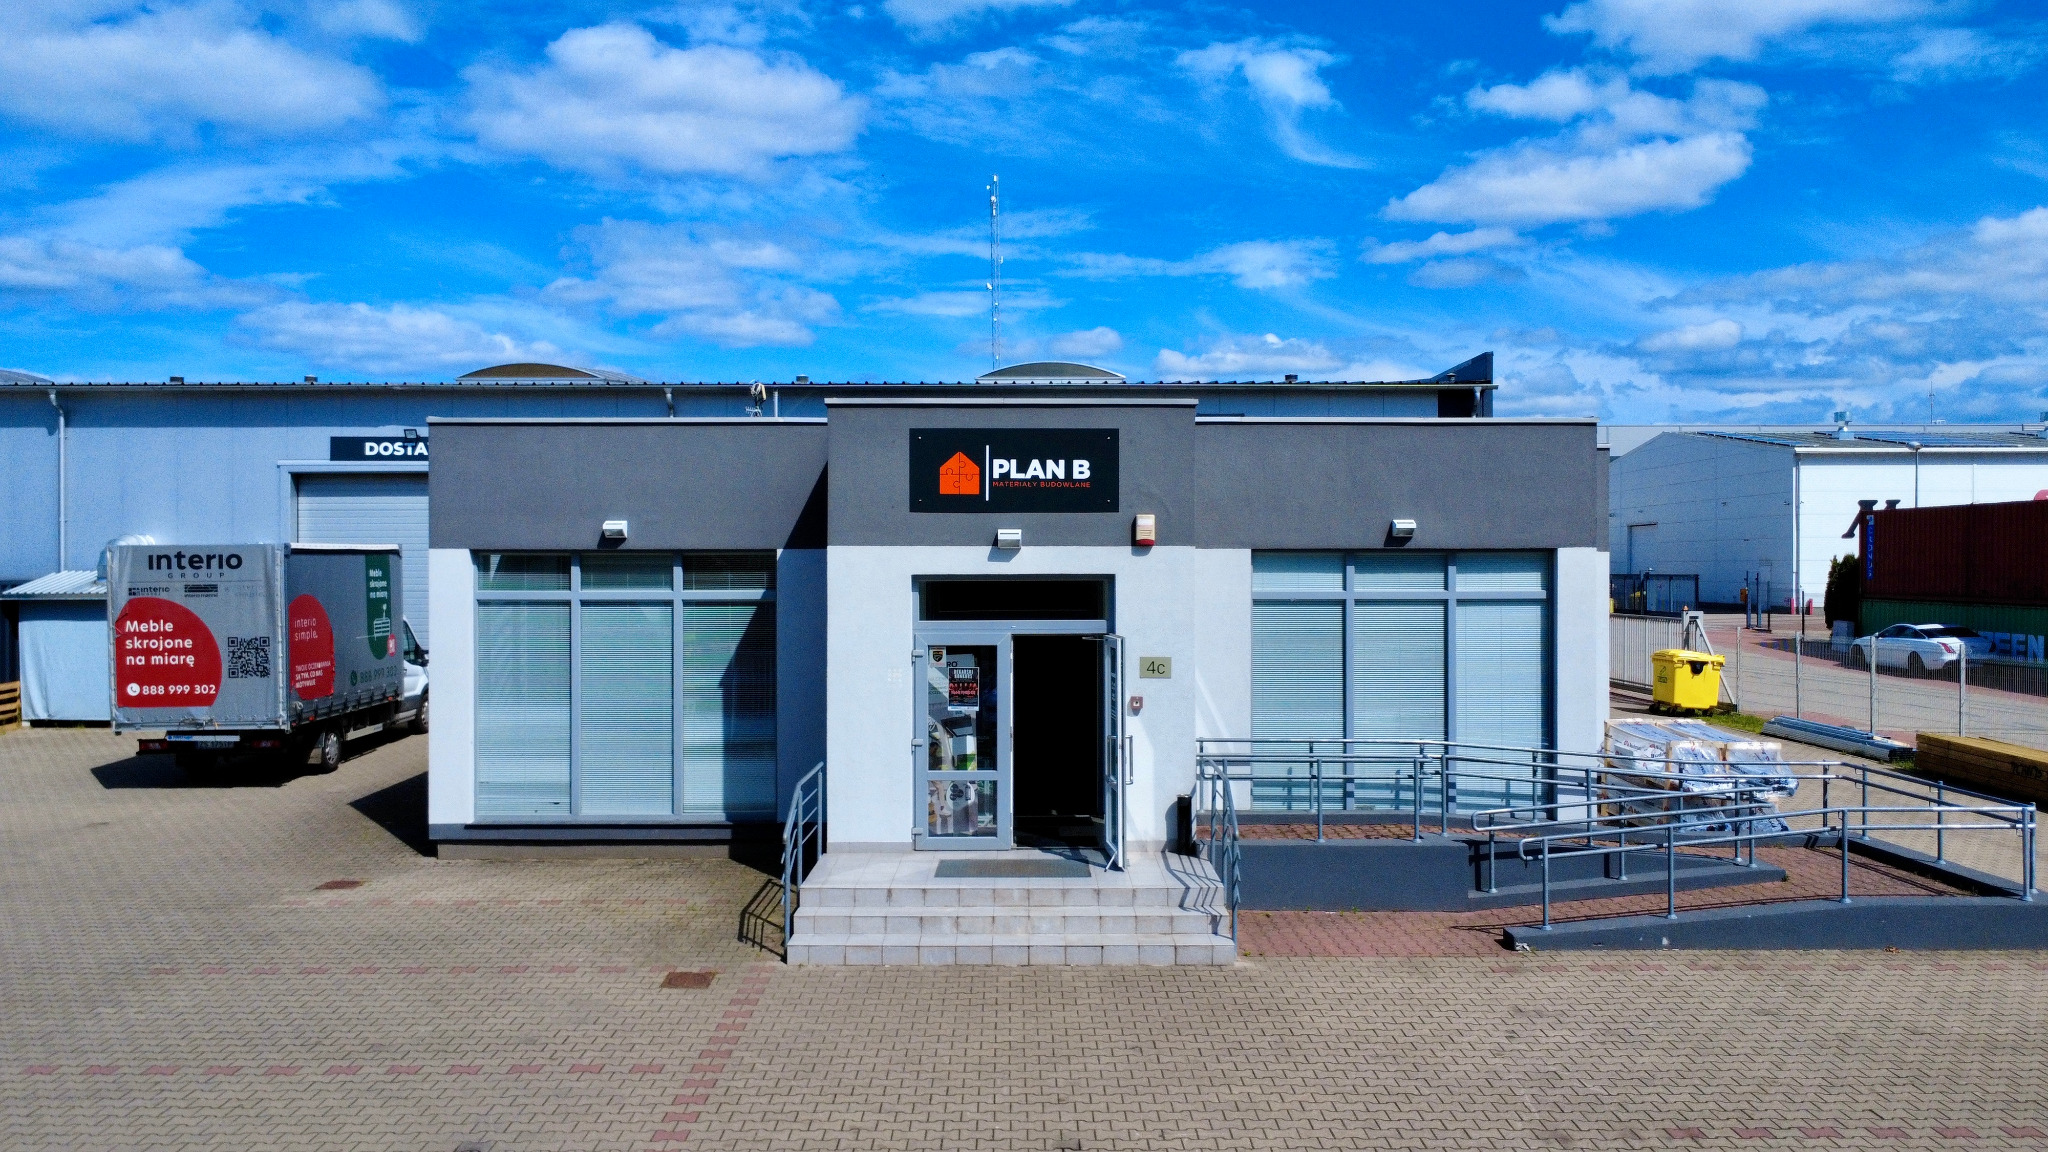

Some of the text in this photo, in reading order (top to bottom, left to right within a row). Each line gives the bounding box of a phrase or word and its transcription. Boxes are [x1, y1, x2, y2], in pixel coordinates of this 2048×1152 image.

[365, 442, 429, 456] DOSTA
[992, 459, 1091, 480] PLAN B
[148, 551, 243, 571] interio
[125, 619, 174, 633] Meble
[294, 617, 317, 629] interio
[125, 636, 193, 651] skrojone
[126, 653, 195, 667] na miarę
[142, 684, 216, 695] 888 999 302
